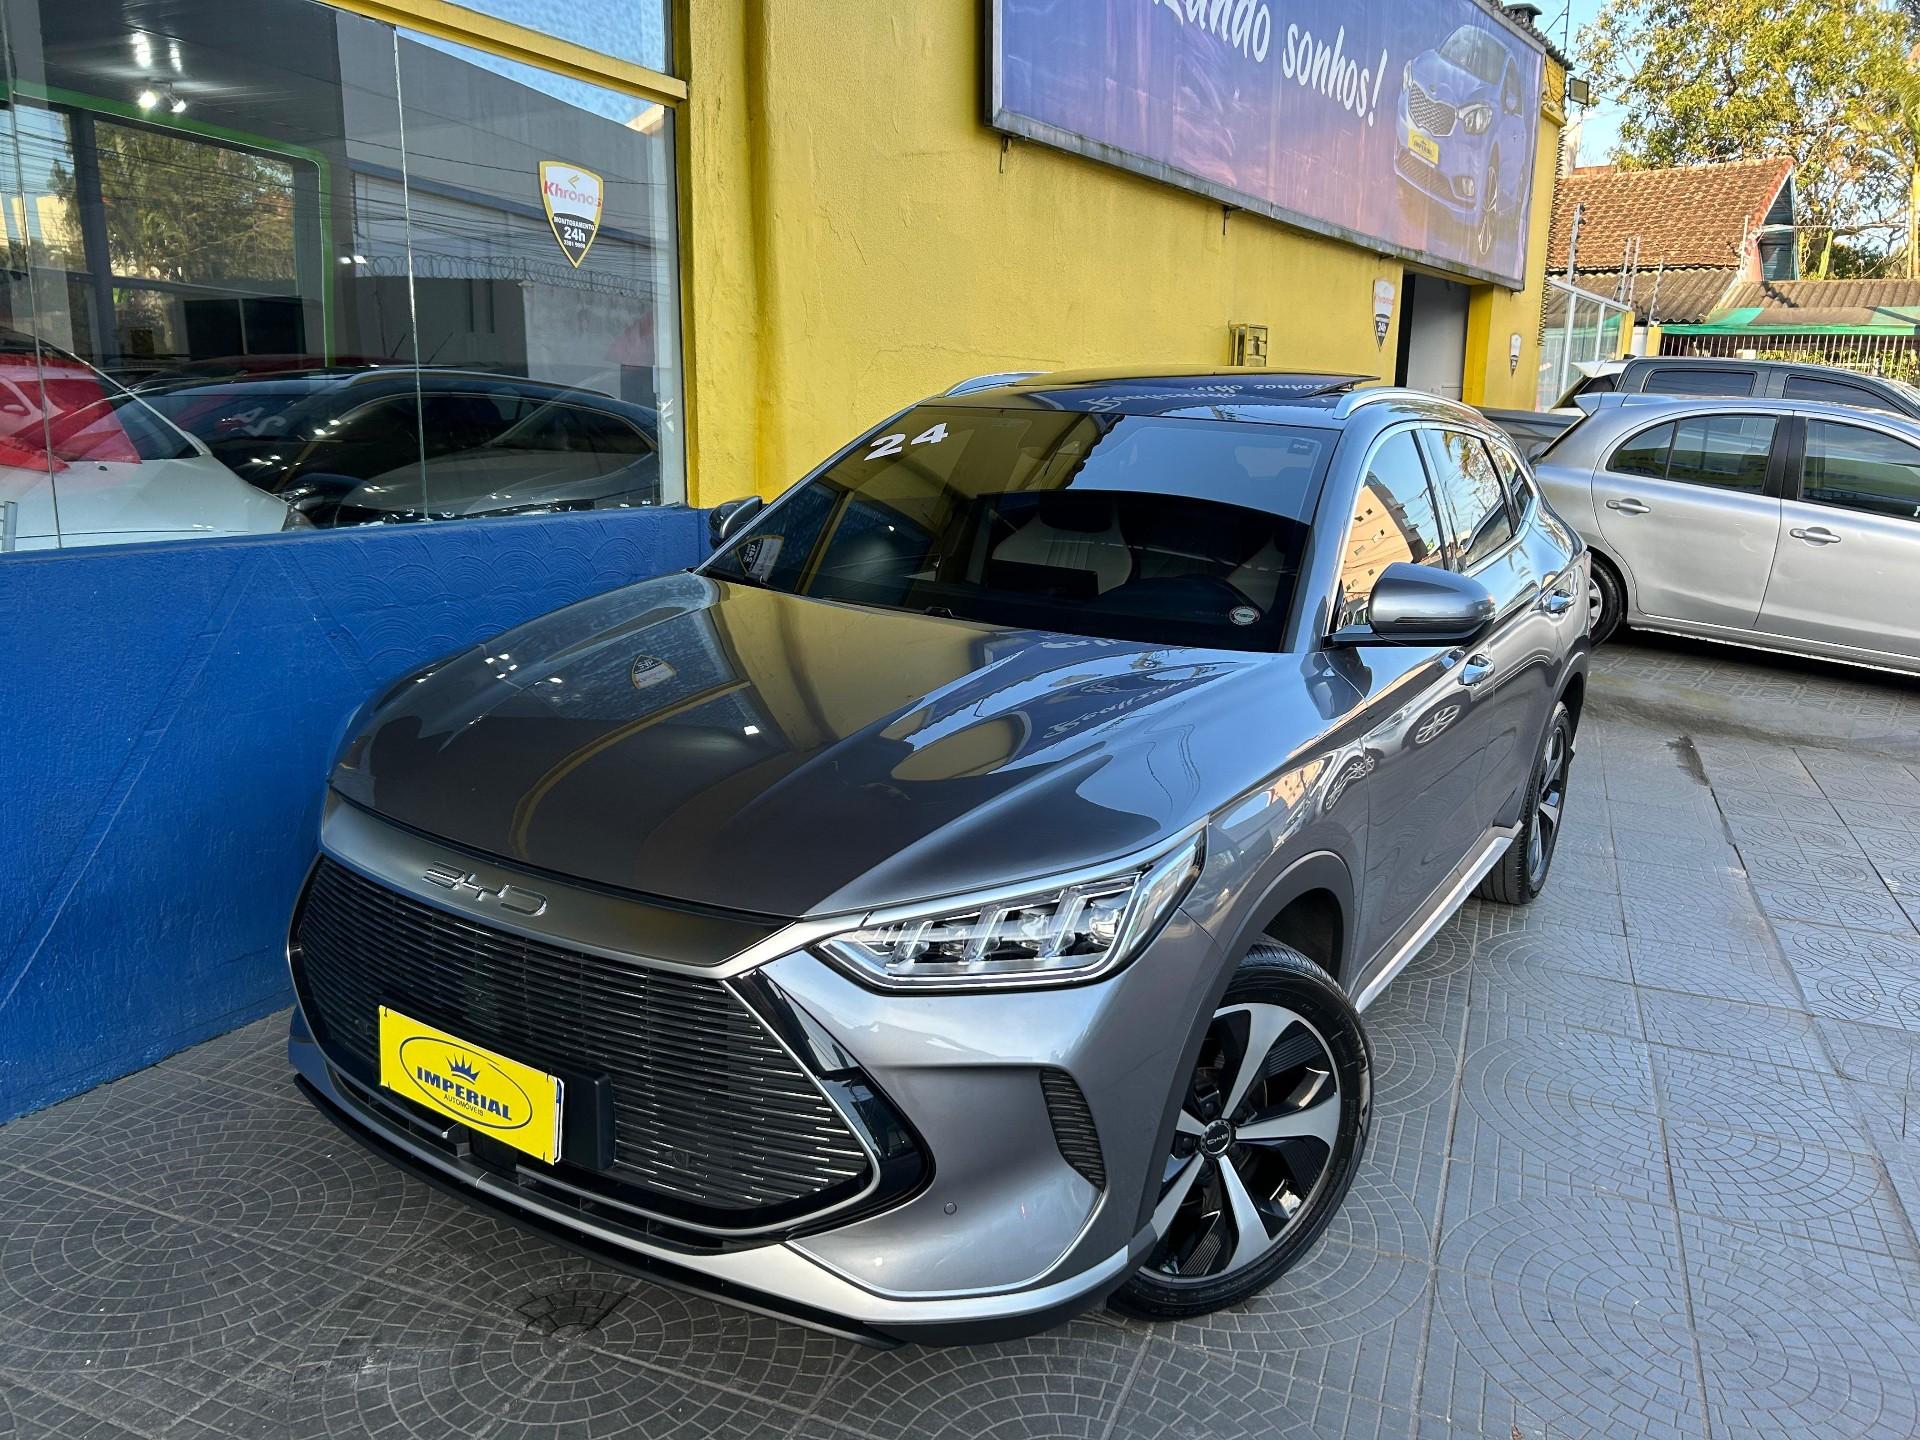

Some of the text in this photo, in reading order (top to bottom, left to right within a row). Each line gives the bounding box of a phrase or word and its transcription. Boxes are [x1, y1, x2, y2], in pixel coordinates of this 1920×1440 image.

[1282, 23, 1388, 127] sonhos!
[544, 181, 602, 207] Khronos
[563, 226, 586, 242] 24h
[863, 422, 949, 462] 24
[422, 861, 547, 916] BYD
[416, 1065, 513, 1121] IMPERIAL
[443, 1093, 484, 1117] AUTOMÓVEIS
